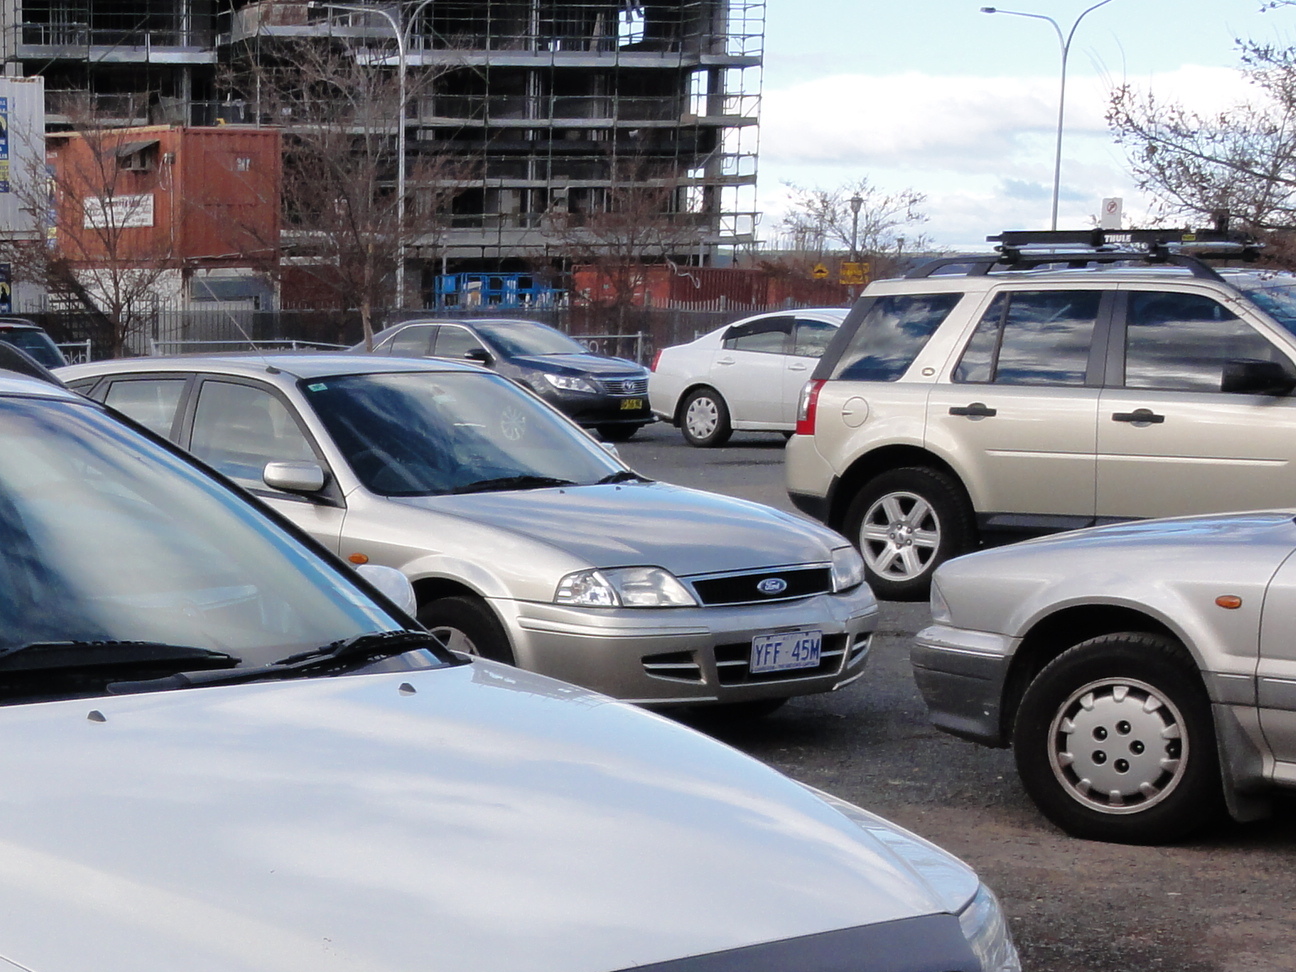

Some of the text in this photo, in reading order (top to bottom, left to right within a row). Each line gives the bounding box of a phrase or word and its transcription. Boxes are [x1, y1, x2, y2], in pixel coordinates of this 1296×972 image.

[1104, 234, 1132, 243] THULE
[756, 638, 820, 666] YFF 45M
